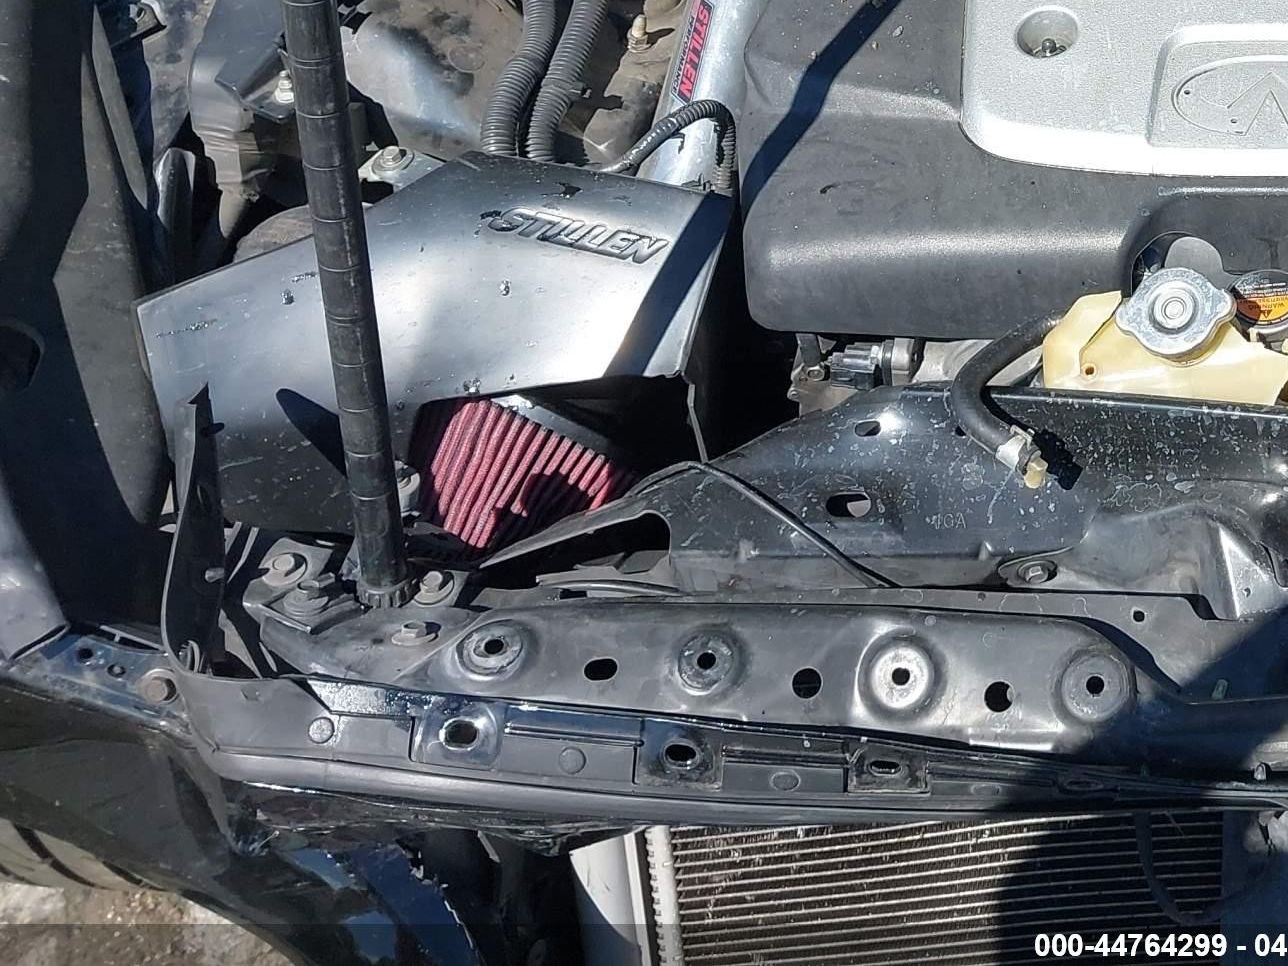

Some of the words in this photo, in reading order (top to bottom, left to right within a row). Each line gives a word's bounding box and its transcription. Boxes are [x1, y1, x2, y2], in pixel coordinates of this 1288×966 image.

[672, 15, 695, 95] PERFORMANCE
[679, 5, 710, 100] STILLEN
[488, 207, 669, 264] STILLEN
